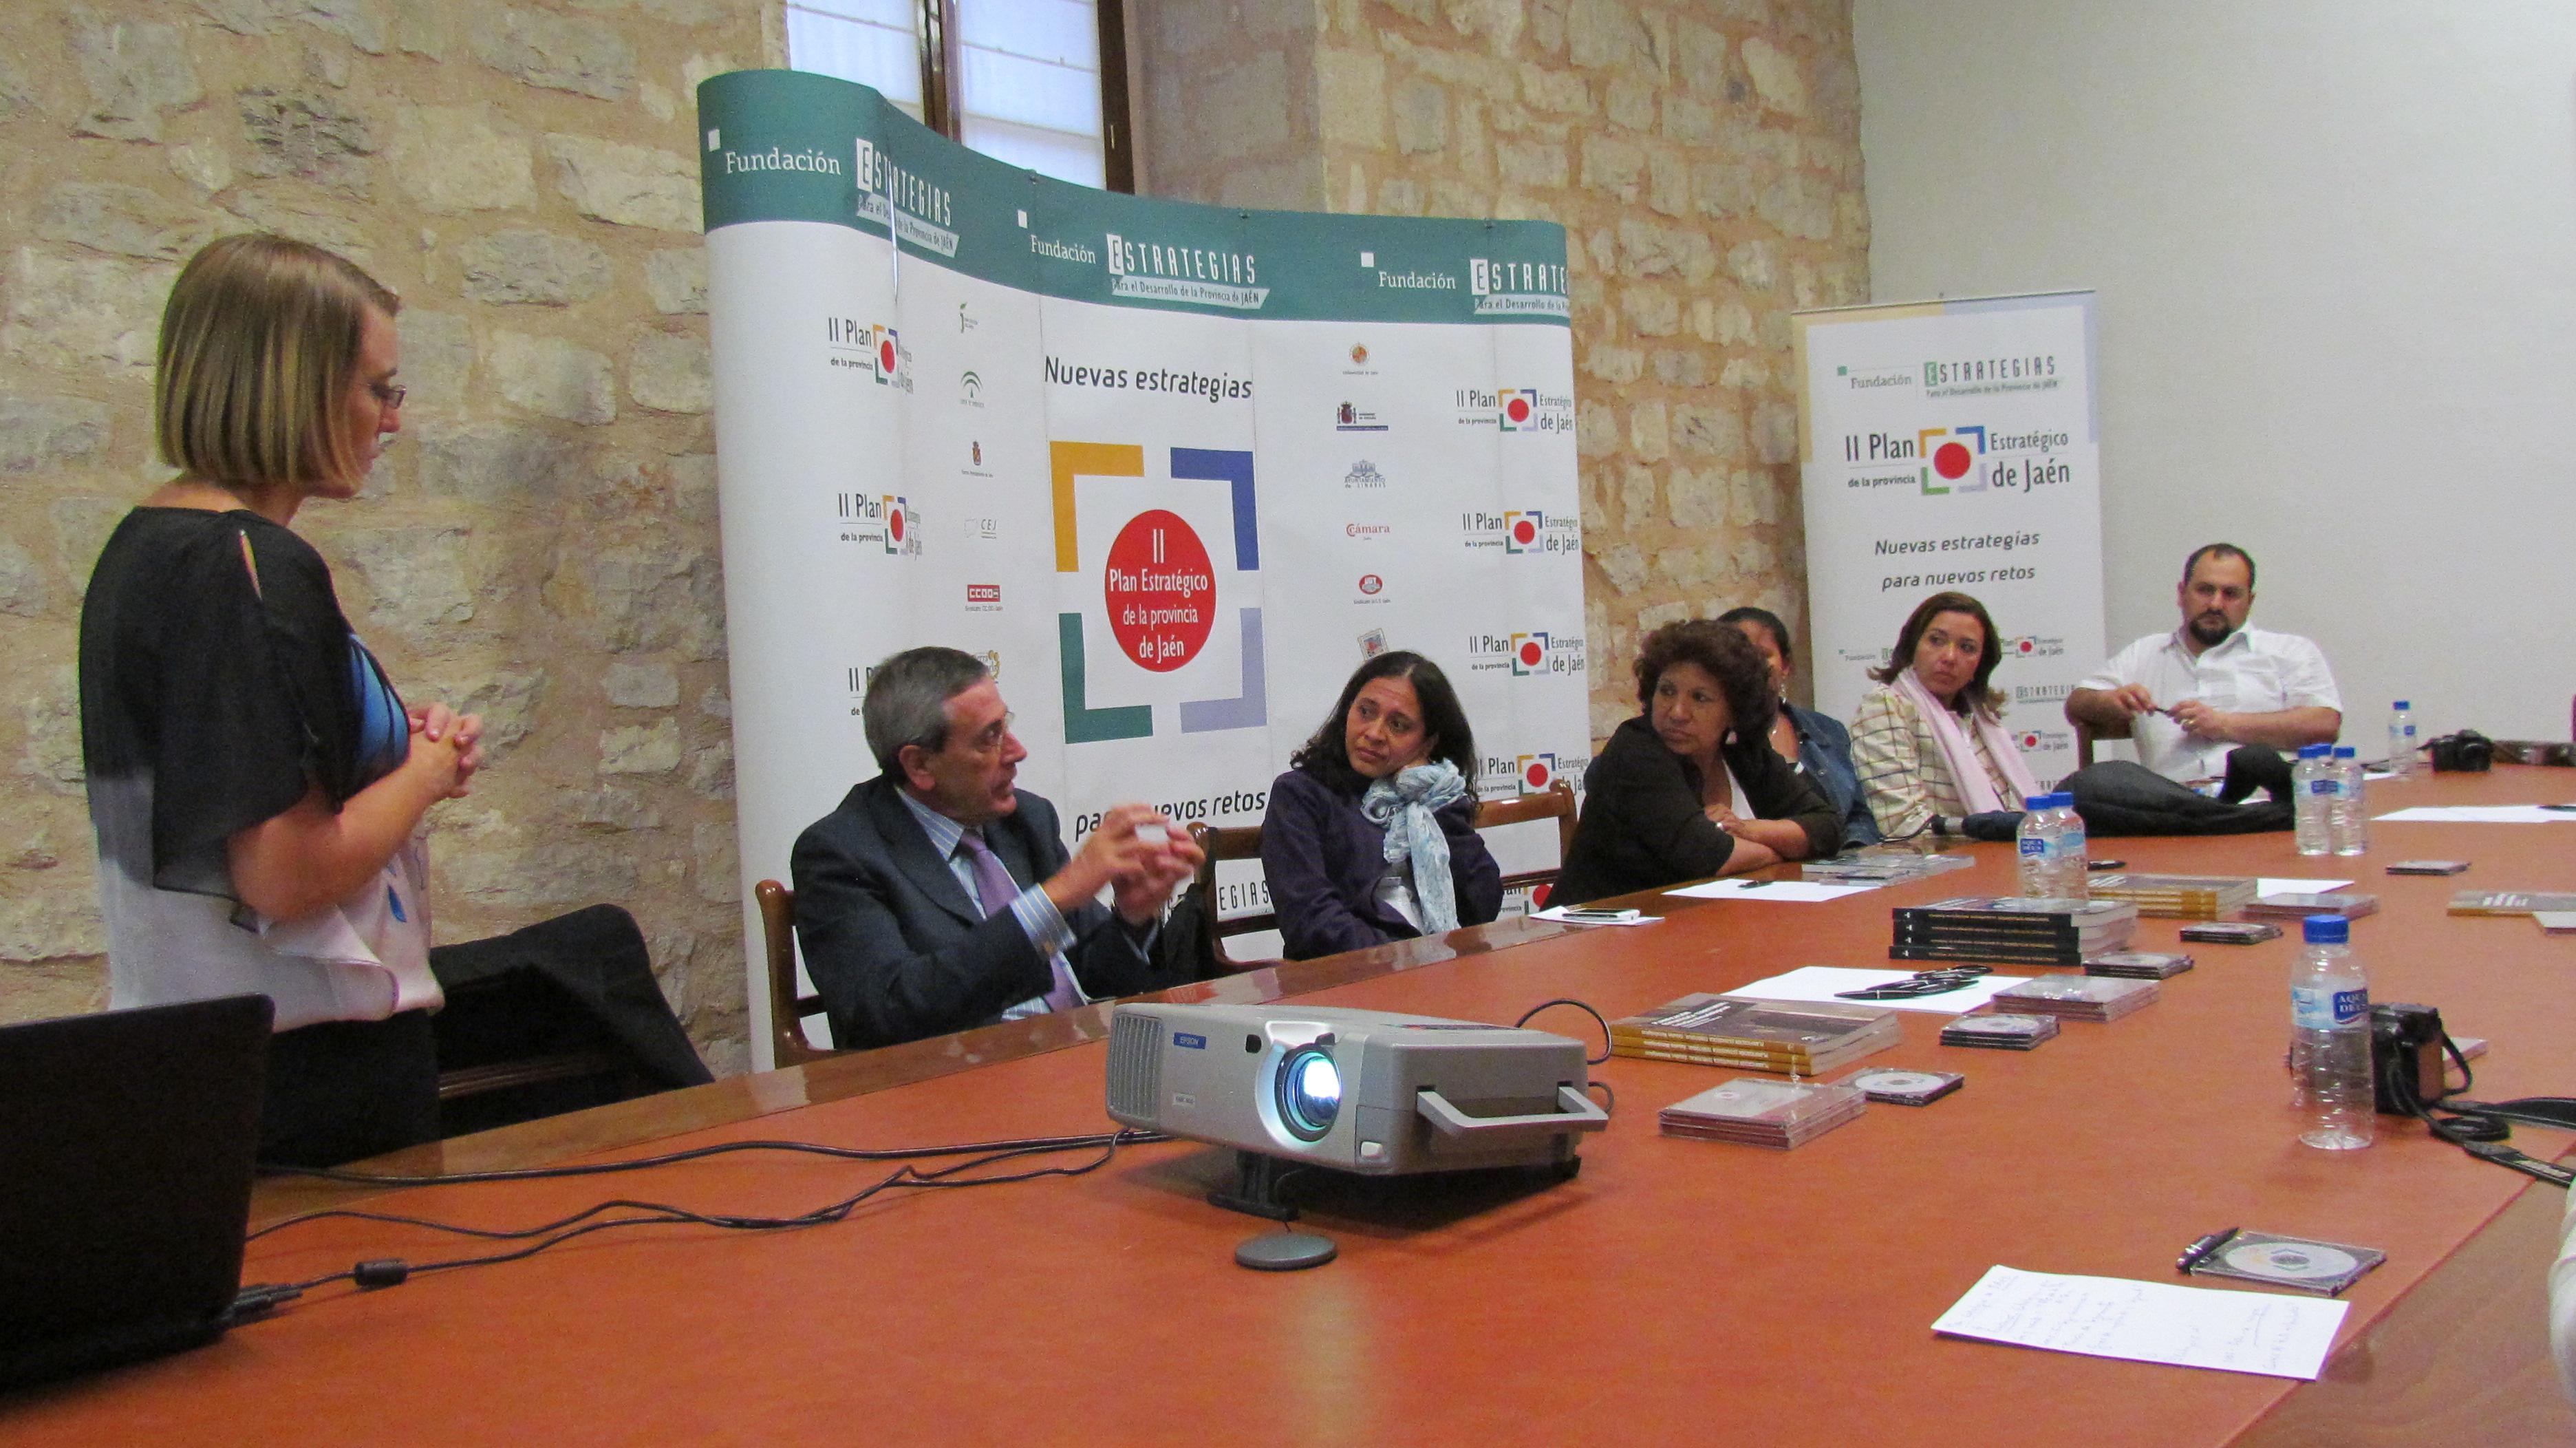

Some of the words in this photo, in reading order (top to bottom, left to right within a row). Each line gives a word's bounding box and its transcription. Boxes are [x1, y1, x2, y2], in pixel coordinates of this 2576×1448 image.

[726, 147, 841, 175] Fundación
[857, 138, 952, 227] ESTATEGIAS
[1030, 234, 1097, 265] Fundación
[1106, 233, 1256, 284] ESTRATEGIAS
[1378, 270, 1457, 290] Fundación
[1470, 259, 1569, 295] ESTRATE
[1111, 277, 1128, 292] Para
[1131, 280, 1138, 292] el
[1140, 281, 1179, 297] Desarrollo
[1181, 285, 1189, 297] de
[1191, 286, 1198, 298] la
[1200, 286, 1231, 301] Provincia
[1241, 289, 1260, 306] JAÉN
[1495, 299, 1503, 310] el
[1505, 297, 1545, 310] Desarrollo
[828, 317, 839, 343] II
[846, 319, 872, 348] Plan
[830, 357, 840, 367] de
[841, 357, 848, 368] la
[1851, 374, 1912, 389] Fundación
[1924, 355, 2055, 387] ESTRATEGIAS
[1044, 355, 1128, 389] Nuevas
[1135, 368, 1254, 403] estrategias
[1457, 390, 1464, 407] II
[1469, 390, 1496, 407] Plan
[1541, 413, 1554, 430] de
[1845, 435, 1858, 462] II
[1869, 433, 1915, 460] Plan
[1990, 428, 2070, 454] Estratégico
[1848, 477, 1860, 488] de
[1862, 476, 1870, 487] la
[1872, 473, 1916, 488] provincia
[1992, 462, 2017, 488] de
[2024, 457, 2070, 493] Jaén
[838, 493, 850, 518] II
[856, 493, 882, 520] Plan
[1463, 513, 1471, 531] II
[1476, 513, 1503, 531] Plan
[841, 532, 850, 542] de
[851, 532, 858, 542] la
[859, 532, 883, 544] provincia
[1152, 529, 1165, 564] II
[1479, 540, 1504, 549] provincia
[1546, 534, 1559, 551] de
[1561, 533, 1580, 556] Jaén
[1874, 540, 1937, 556] Nuevas
[1941, 531, 2041, 551] estrategias
[1109, 568, 1137, 593] Plan
[1141, 568, 1209, 598] Estratégico
[1882, 573, 1920, 593] para
[1925, 568, 1986, 586] nuevos
[1990, 566, 2036, 582] retos
[1123, 603, 1136, 626] de
[1139, 603, 1148, 625] la
[1150, 604, 1199, 631] provincia
[1139, 635, 1154, 659] de
[1157, 634, 1185, 664] Jaén
[1469, 635, 1478, 654] II
[1483, 635, 1509, 652] Plan
[1485, 662, 1510, 672] provincia
[1552, 654, 1565, 672] de
[1567, 654, 1585, 677] Jaén
[849, 667, 860, 692] II
[851, 707, 860, 716] de
[1488, 757, 1515, 775] Plan
[1075, 812, 1102, 842] pa
[1212, 791, 1267, 816] retos
